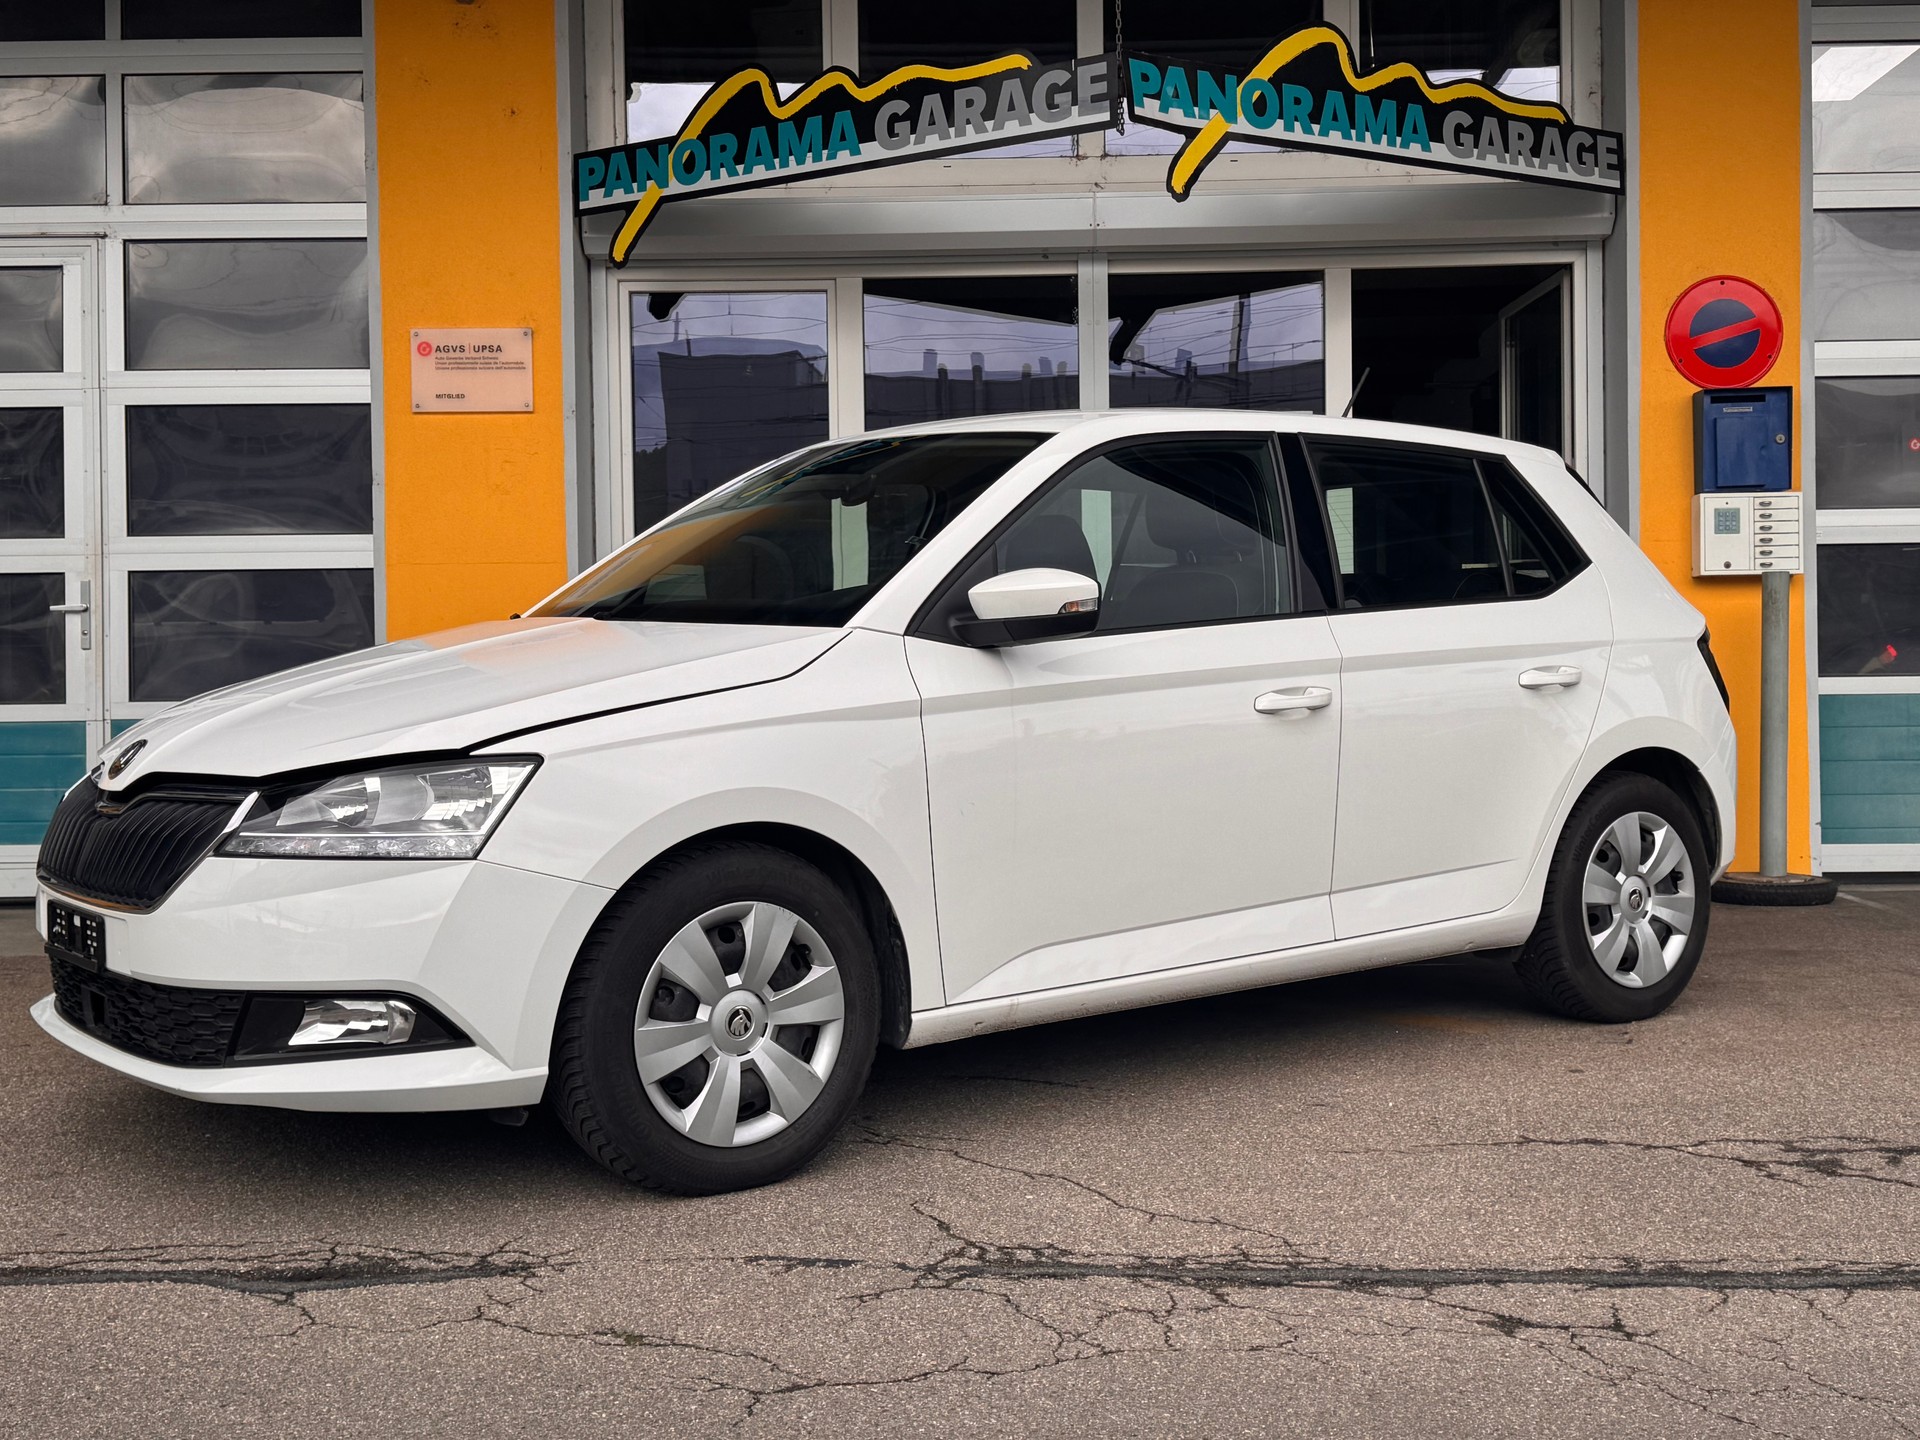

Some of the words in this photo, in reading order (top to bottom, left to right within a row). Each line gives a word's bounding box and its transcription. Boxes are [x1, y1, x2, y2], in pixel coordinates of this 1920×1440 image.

[578, 109, 862, 202] PANORAMA
[873, 61, 1109, 151] GARAGE
[1128, 58, 1432, 153] PANORAMA
[1442, 110, 1621, 180] GARAGE
[434, 344, 466, 353] AGVS
[473, 344, 503, 353] UPSA
